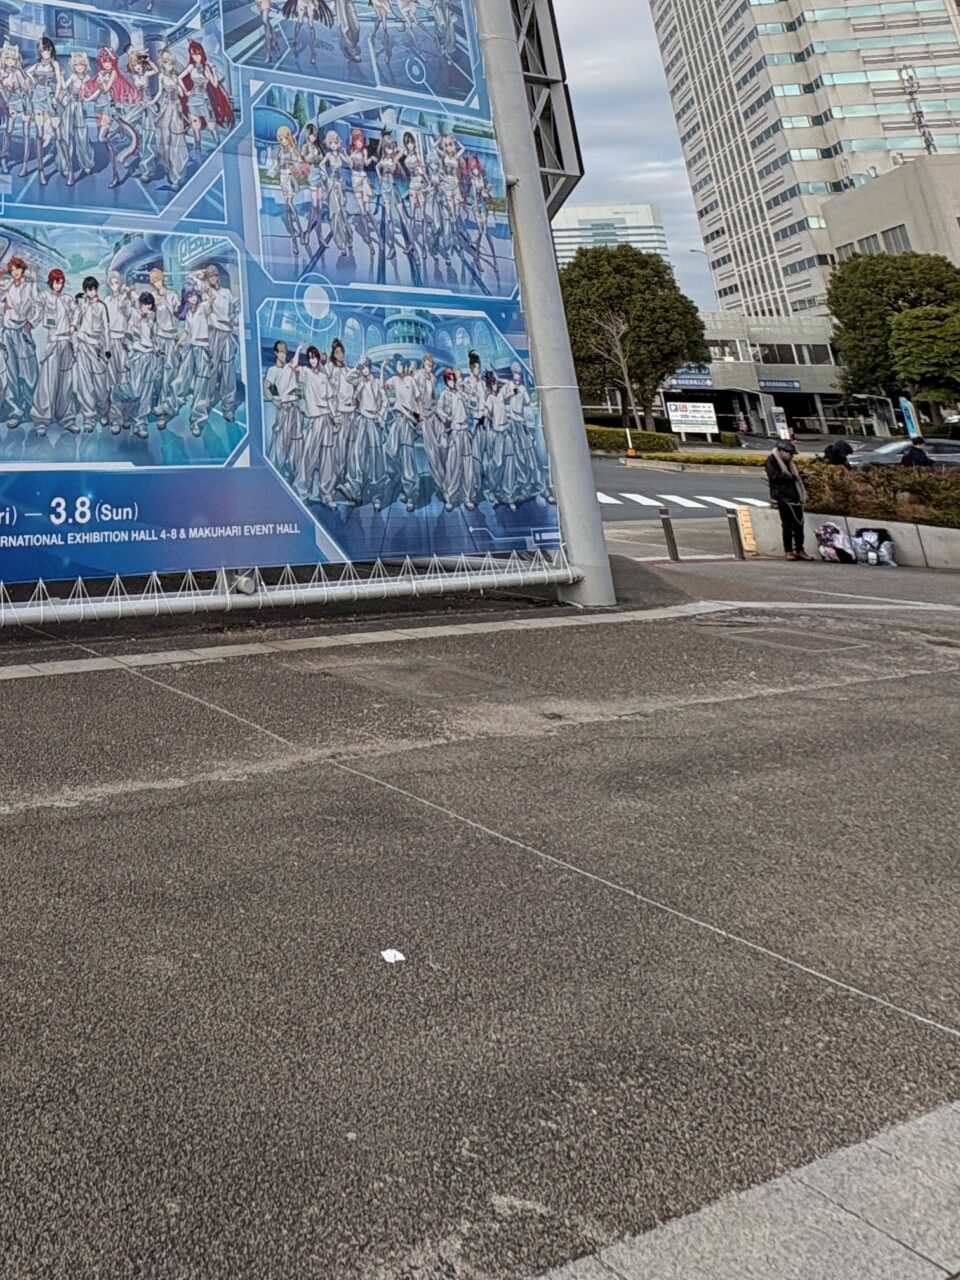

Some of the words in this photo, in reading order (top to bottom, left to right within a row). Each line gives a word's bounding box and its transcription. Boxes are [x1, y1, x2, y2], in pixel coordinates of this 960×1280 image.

[49, 496, 91, 525] 3.8
[95, 500, 139, 523] (Sun)
[67, 530, 129, 545] EXHIBITION
[131, 529, 158, 542] HALL
[160, 528, 177, 540] 4-8
[179, 528, 187, 539] &
[188, 525, 241, 539] MAKUHARI
[243, 524, 274, 537] EVENT
[276, 523, 301, 534] HALL
